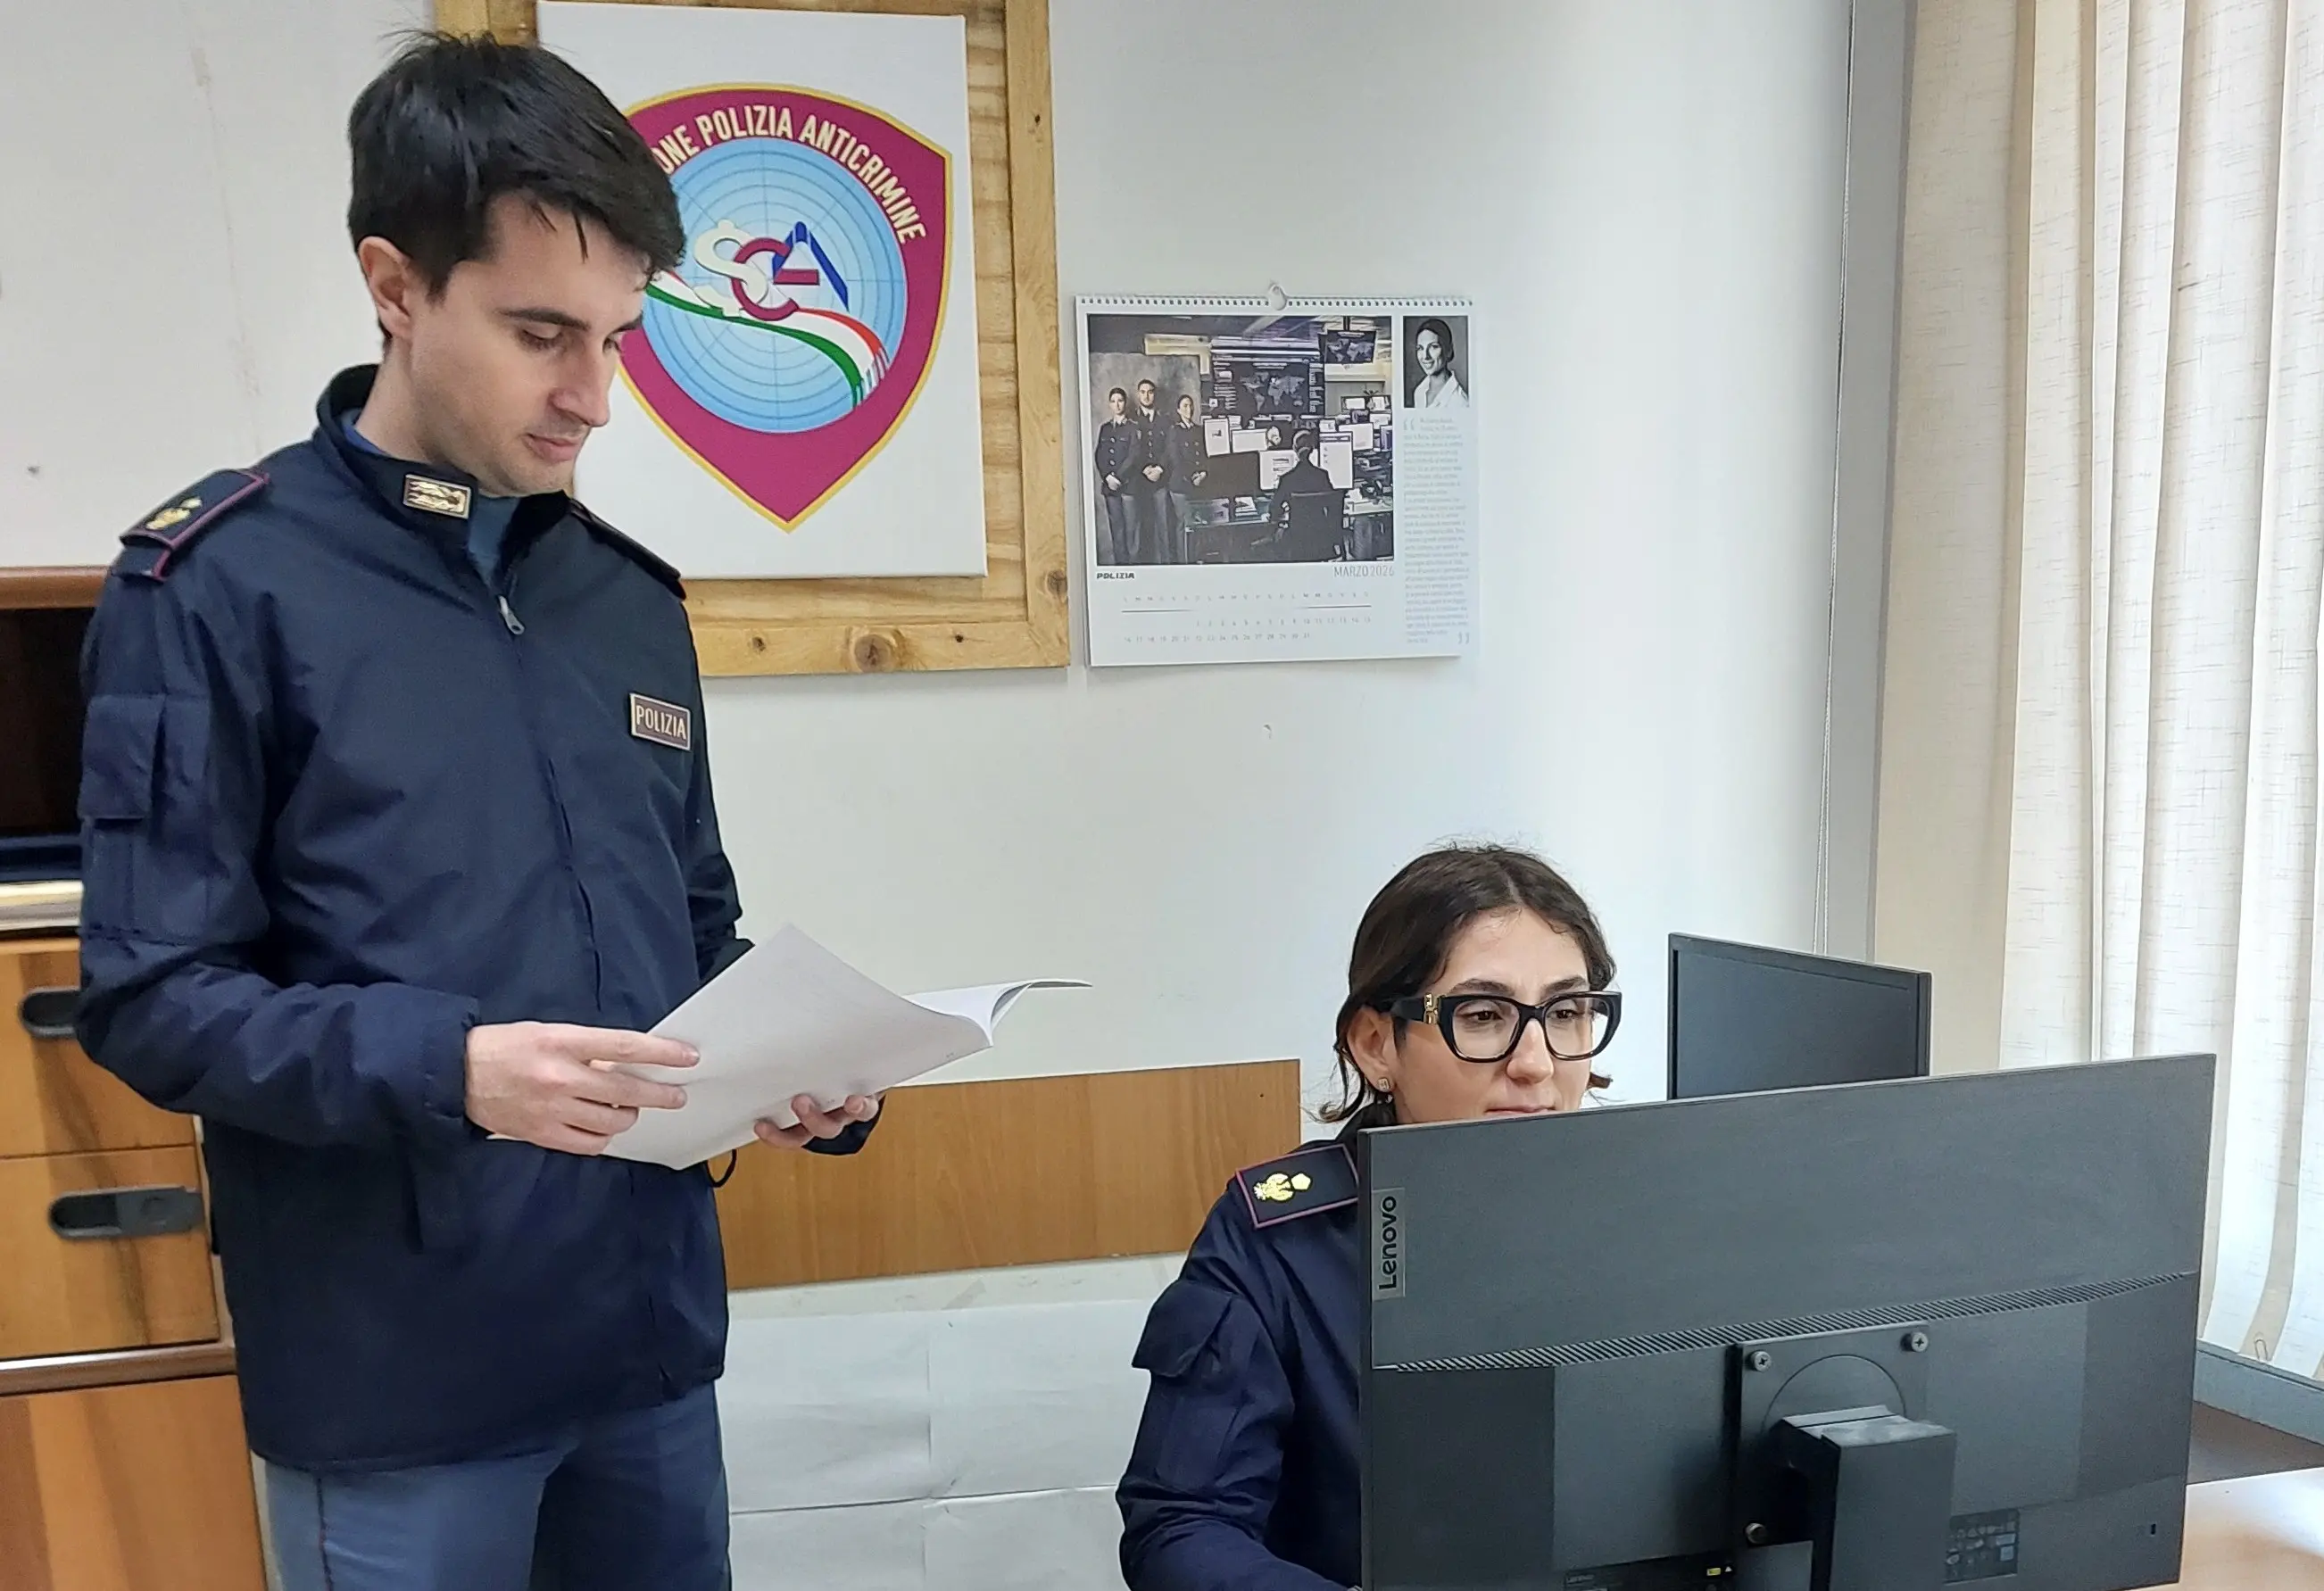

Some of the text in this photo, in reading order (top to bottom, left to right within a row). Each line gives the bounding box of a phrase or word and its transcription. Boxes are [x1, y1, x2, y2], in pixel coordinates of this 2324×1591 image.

[695, 105, 793, 145] POLIZIA
[799, 115, 925, 244] ANTICRIMINE
[636, 705, 686, 740] POLIZIA
[1379, 1197, 1397, 1289] Lenovo
